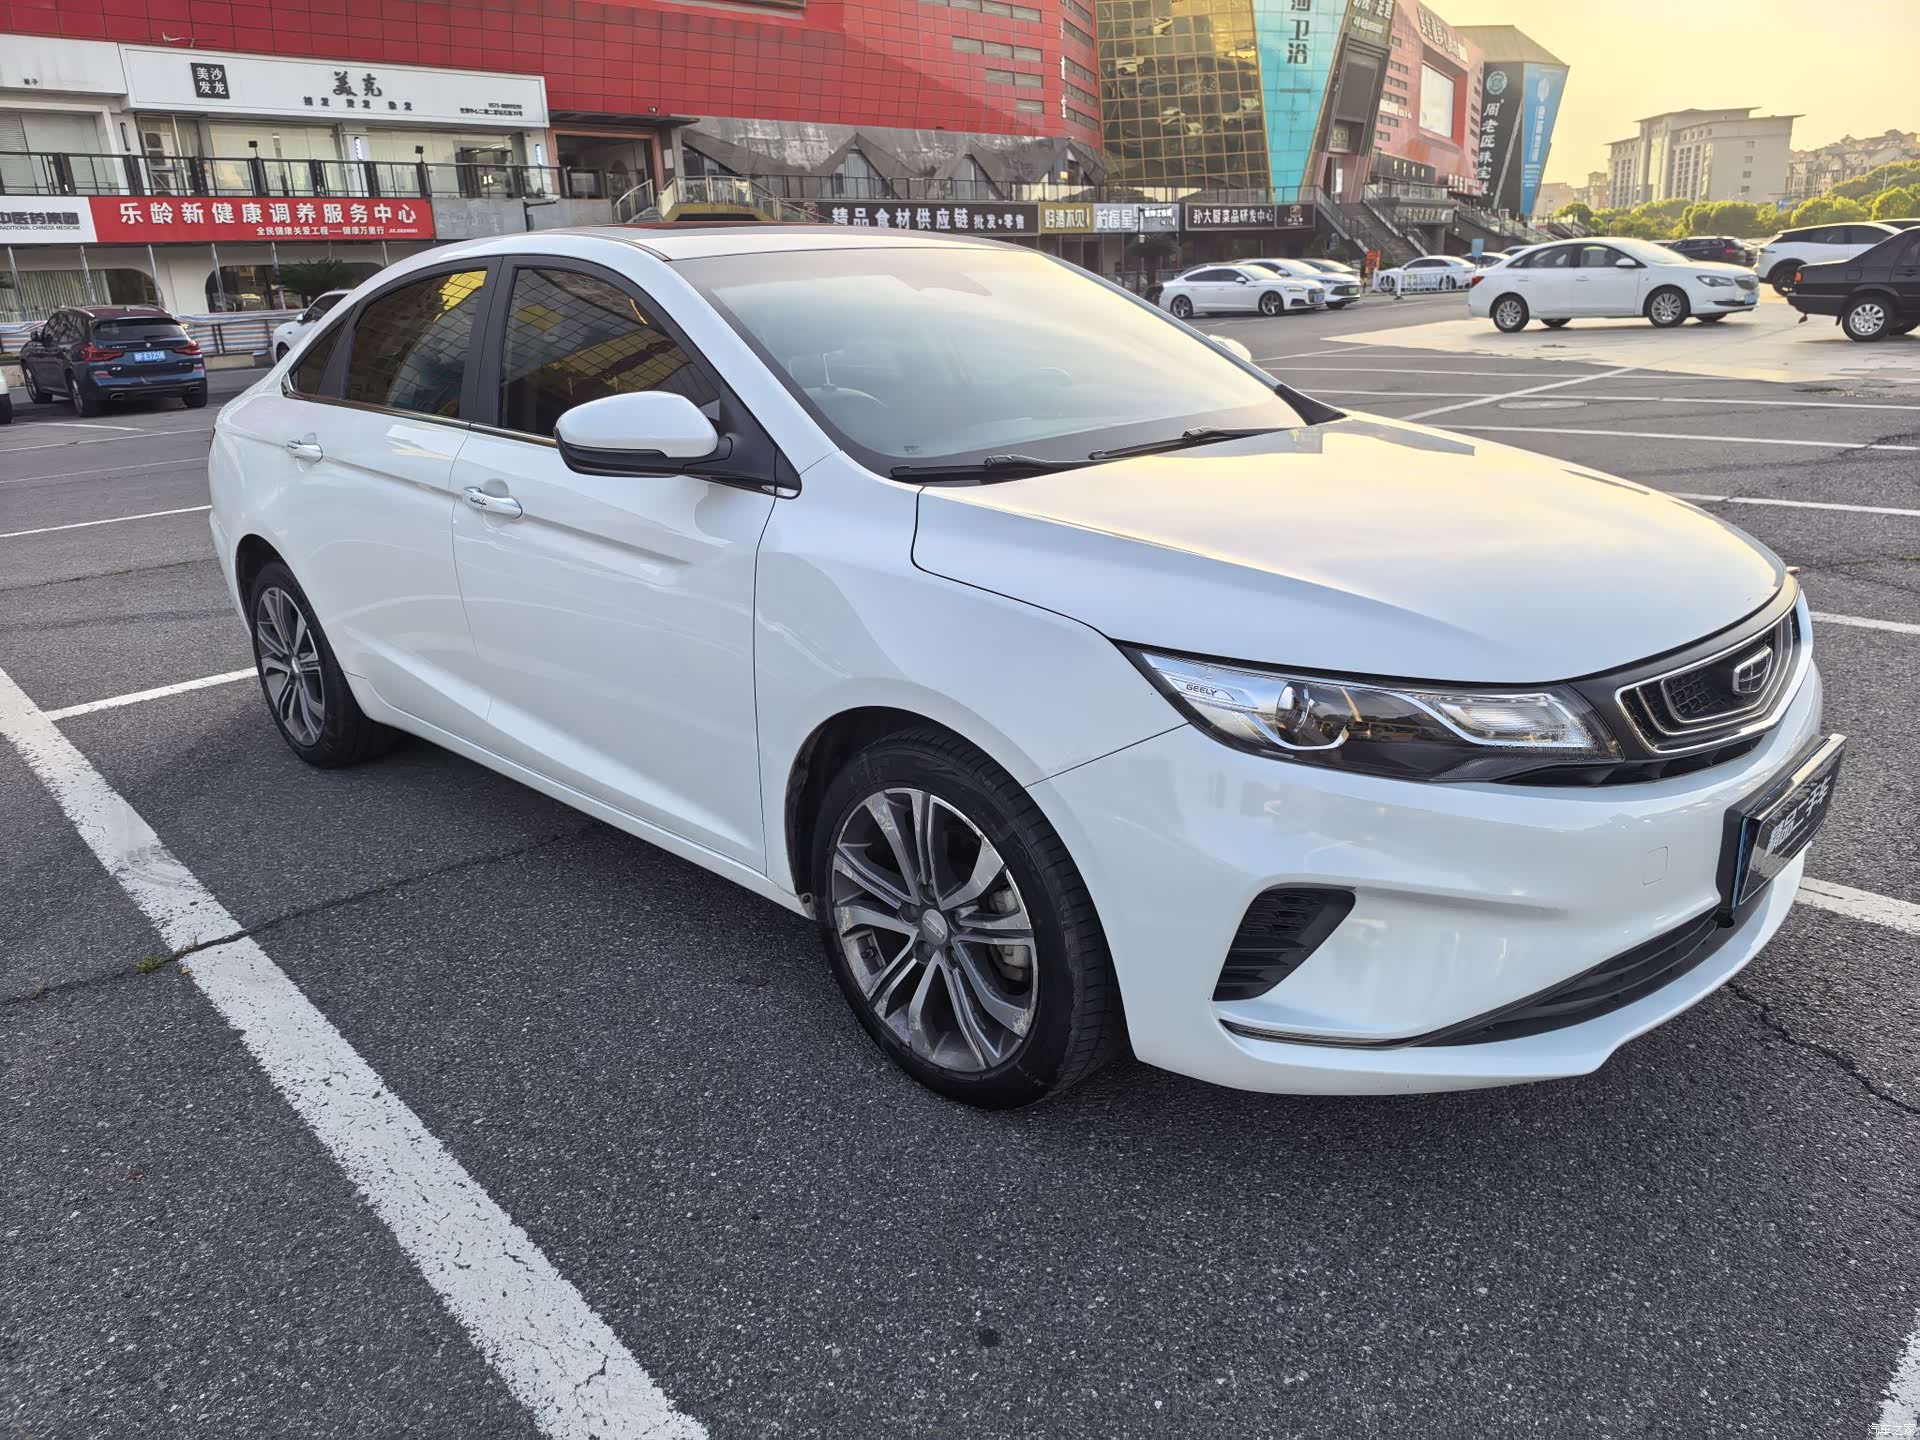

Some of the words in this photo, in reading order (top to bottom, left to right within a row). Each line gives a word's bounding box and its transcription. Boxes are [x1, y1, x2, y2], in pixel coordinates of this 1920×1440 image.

[119, 202, 417, 225] 乐龄新健康调养服务中心
[832, 207, 969, 229] 精品食材供应链
[1185, 683, 1217, 696] GEELY
